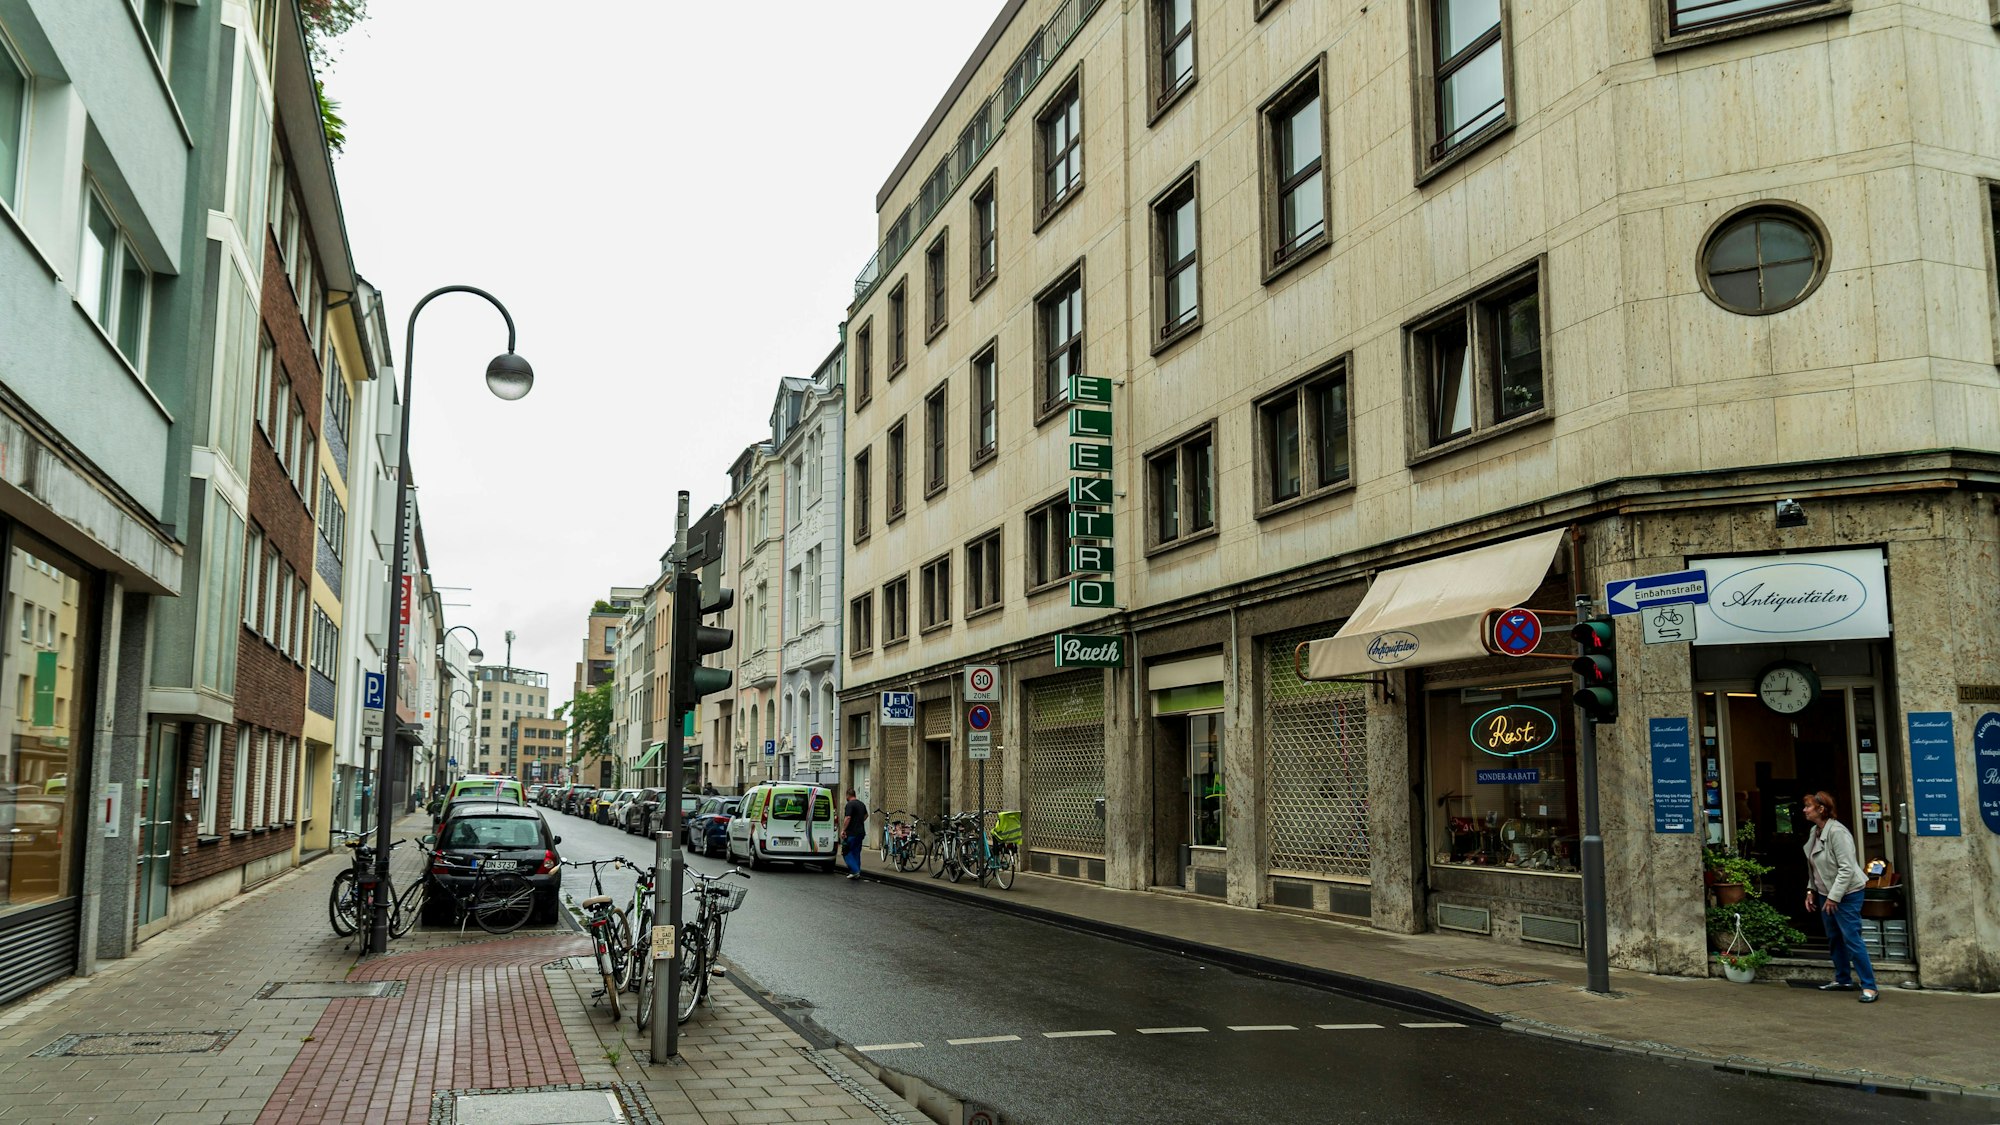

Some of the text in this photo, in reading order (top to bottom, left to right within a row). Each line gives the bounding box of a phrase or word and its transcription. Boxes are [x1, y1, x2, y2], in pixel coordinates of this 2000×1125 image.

[1077, 378, 1103, 604] ELEKTRO
[1635, 583, 1702, 600] Einbahnstraße
[1722, 582, 1849, 612] Antiquitäten
[1063, 639, 1119, 662] Baeth
[1368, 636, 1417, 660] Antiquitäten
[975, 674, 989, 686] 30
[1488, 715, 1534, 747] Rust
[1478, 772, 1537, 781] SONDER-RABATT
